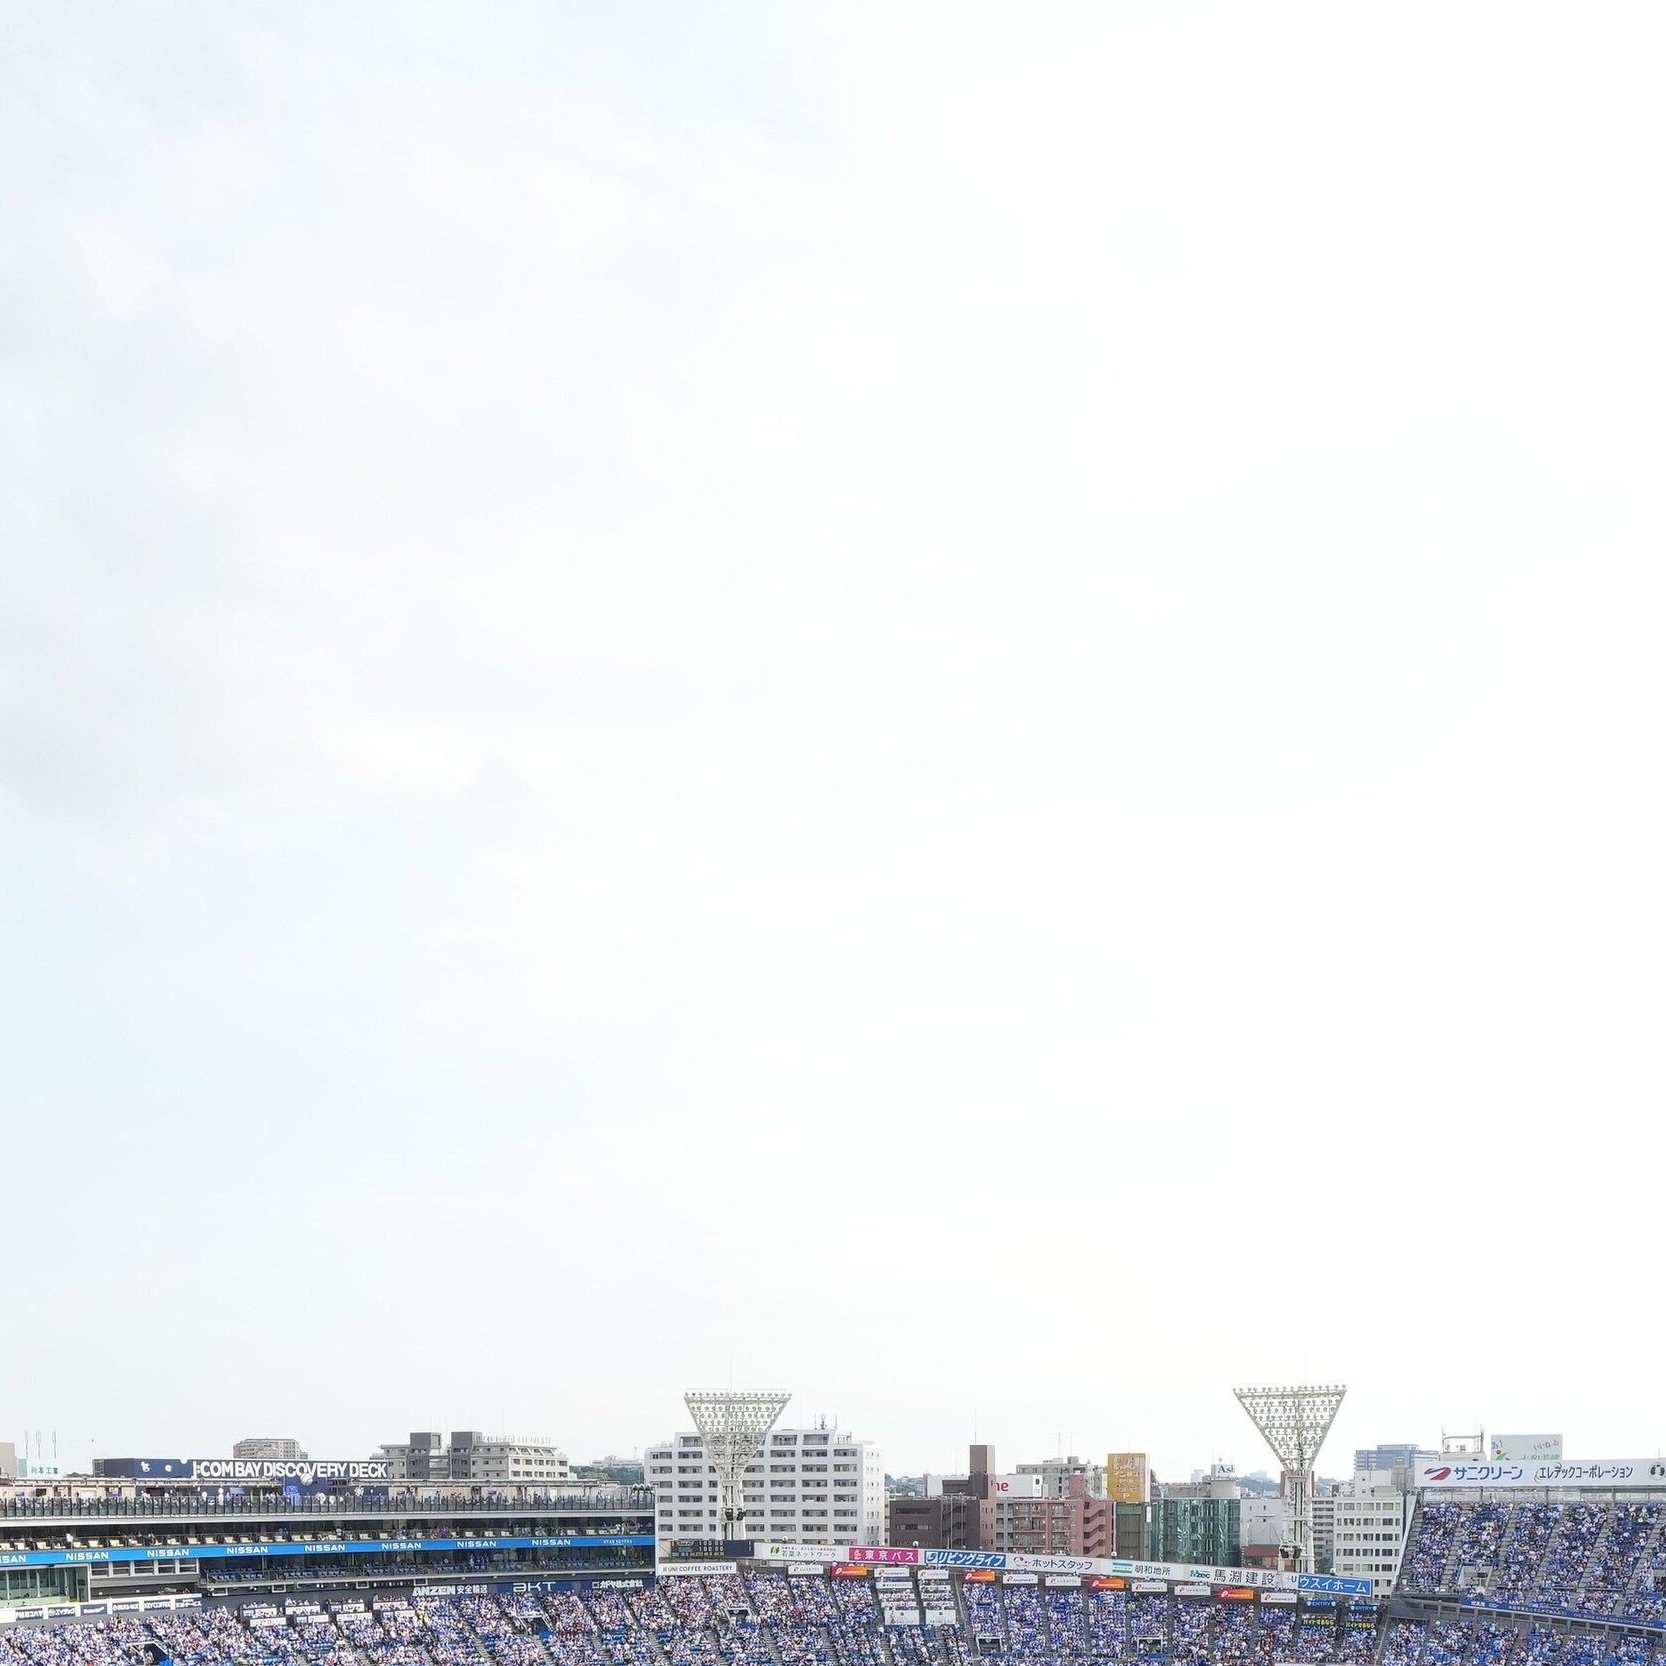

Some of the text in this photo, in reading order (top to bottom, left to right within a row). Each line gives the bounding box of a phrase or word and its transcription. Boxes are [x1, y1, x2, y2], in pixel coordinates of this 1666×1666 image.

[234, 1461, 262, 1478] BAY
[263, 1461, 347, 1478] DISCOVERY
[349, 1461, 388, 1478] DECK
[1454, 1465, 1524, 1480] サニクリーン
[305, 1544, 346, 1552] NISSAN
[382, 1542, 422, 1550] NISSAN
[457, 1540, 497, 1548] NISSAN
[532, 1538, 572, 1546] NISSAN
[147, 1549, 189, 1558] NISSAN
[227, 1546, 268, 1554] NISSAN
[864, 1550, 916, 1562] 東京バス
[66, 1552, 109, 1561] NISSAN
[938, 1551, 1005, 1567] リビングライフ
[1031, 1558, 1093, 1571] ホットスタッフ
[1134, 1563, 1172, 1576] 明和地所
[412, 1585, 456, 1597] ANZEN
[1299, 1575, 1368, 1595] ウスイホーム
